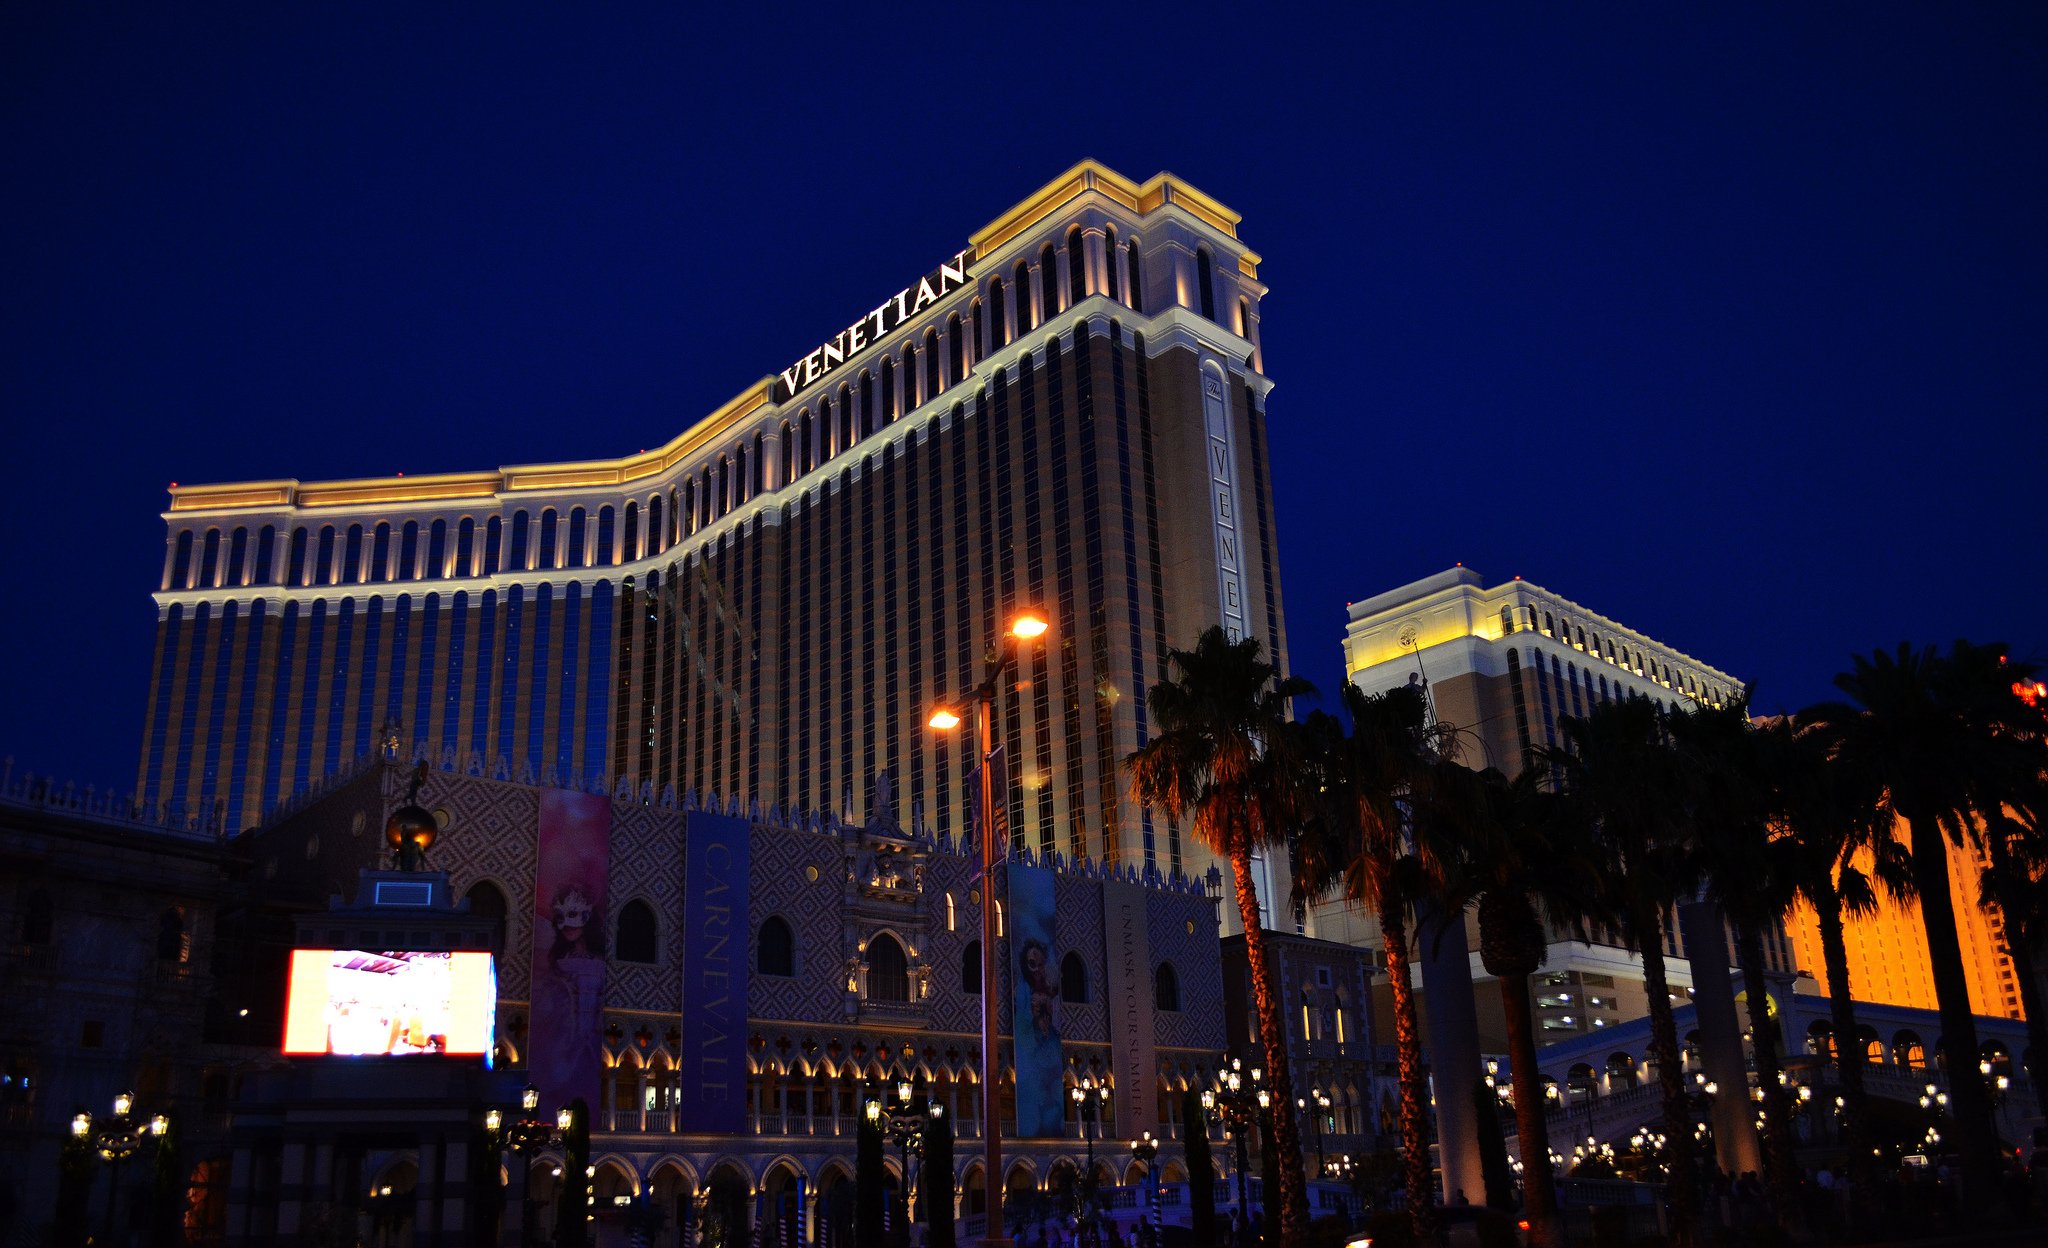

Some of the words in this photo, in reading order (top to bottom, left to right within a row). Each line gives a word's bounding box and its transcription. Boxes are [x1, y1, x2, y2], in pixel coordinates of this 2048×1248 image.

[780, 250, 967, 396] VENETIAN
[701, 842, 732, 1102] CARNEVALE
[1122, 904, 1136, 978] UNMASK
[1126, 984, 1139, 1034] YOUR
[1128, 1037, 1142, 1118] SUMMER
